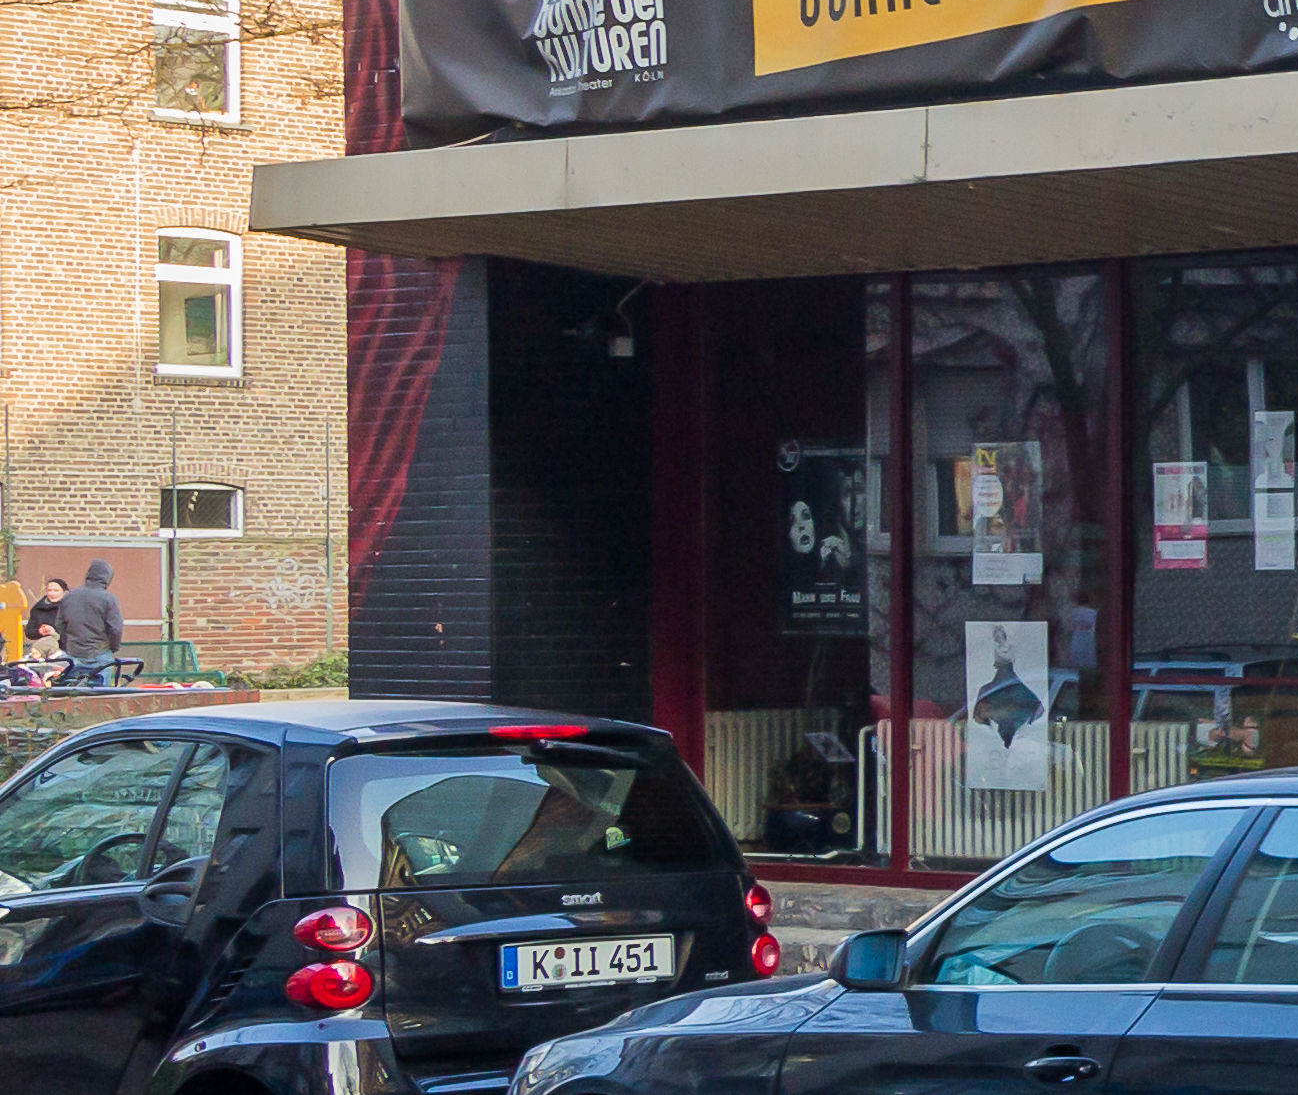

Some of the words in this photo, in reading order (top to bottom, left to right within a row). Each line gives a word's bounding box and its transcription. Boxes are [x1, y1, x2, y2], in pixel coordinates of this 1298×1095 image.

[536, 19, 668, 83] KULTUREN
[560, 892, 604, 906] smart
[532, 949, 550, 980] K
[571, 946, 600, 977] II
[608, 942, 659, 974] 451
